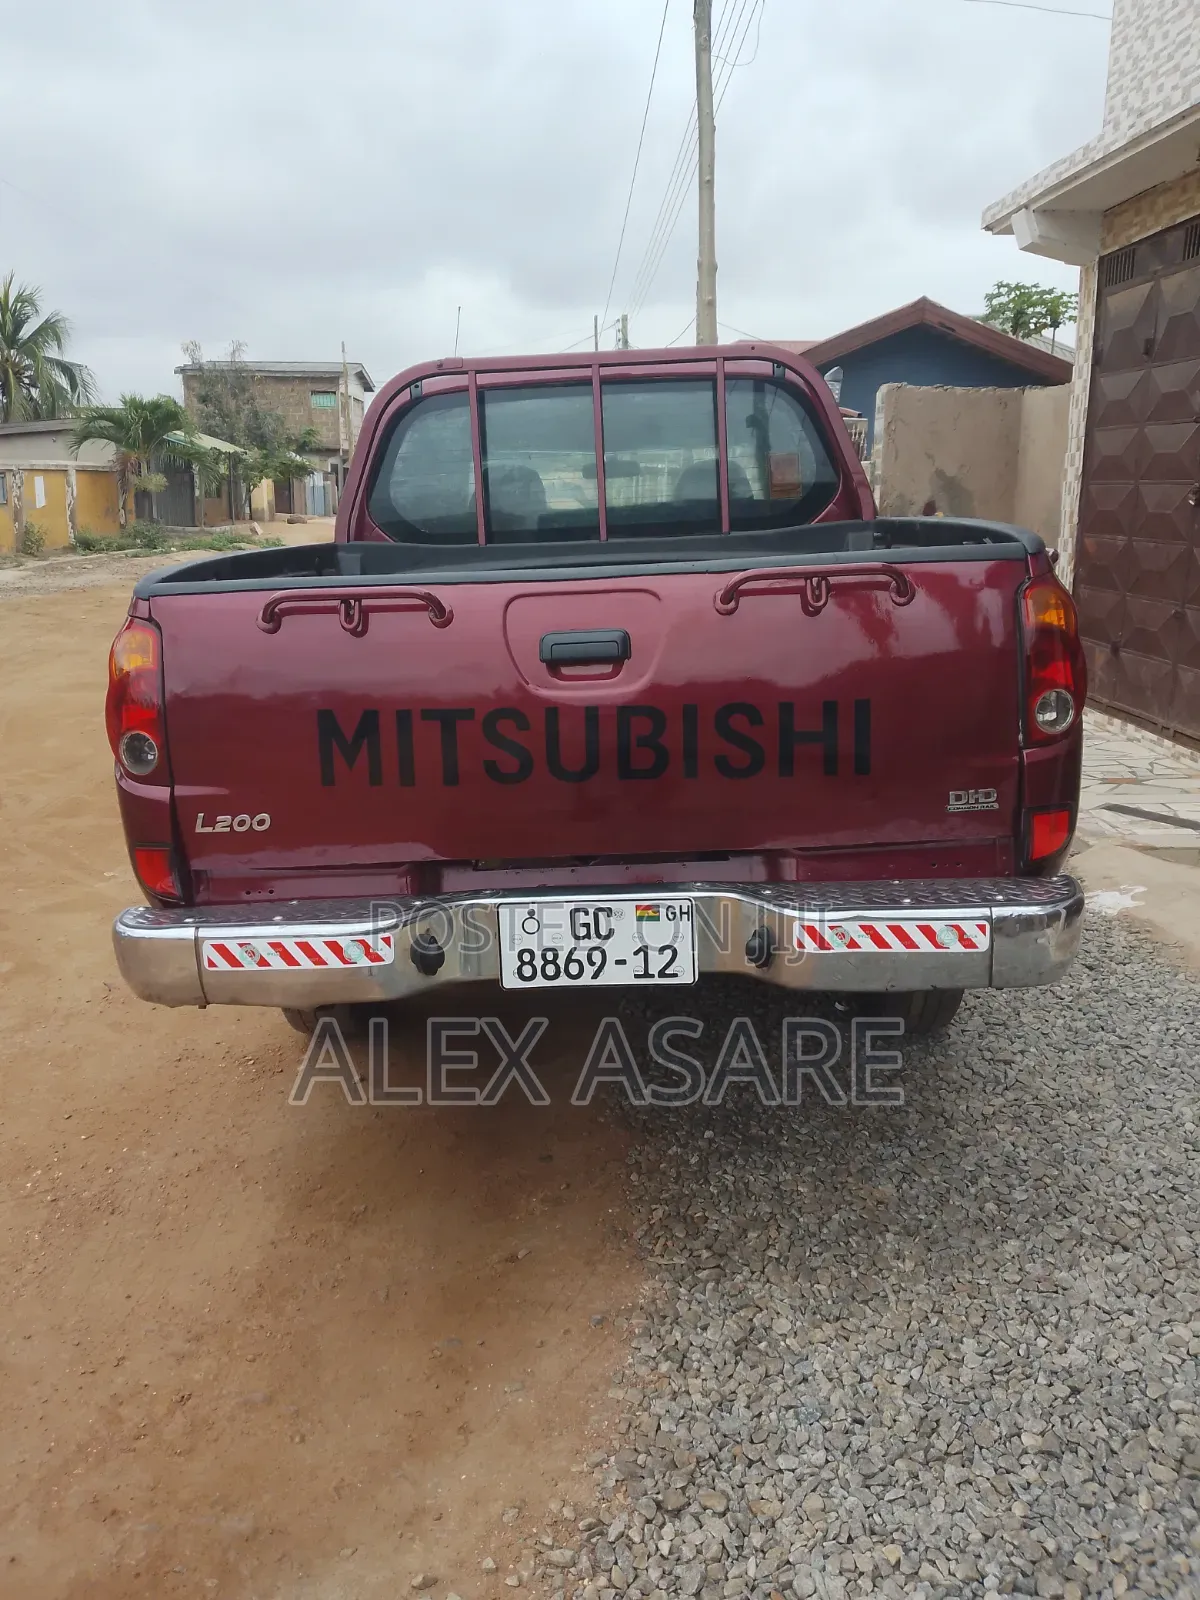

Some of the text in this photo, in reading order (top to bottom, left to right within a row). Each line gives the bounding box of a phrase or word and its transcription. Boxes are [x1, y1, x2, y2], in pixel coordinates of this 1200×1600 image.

[315, 698, 873, 787] MITSUBISHI
[195, 813, 271, 833] L200
[570, 907, 615, 941] GC
[665, 904, 691, 922] GH
[516, 944, 679, 982] 8869-12
